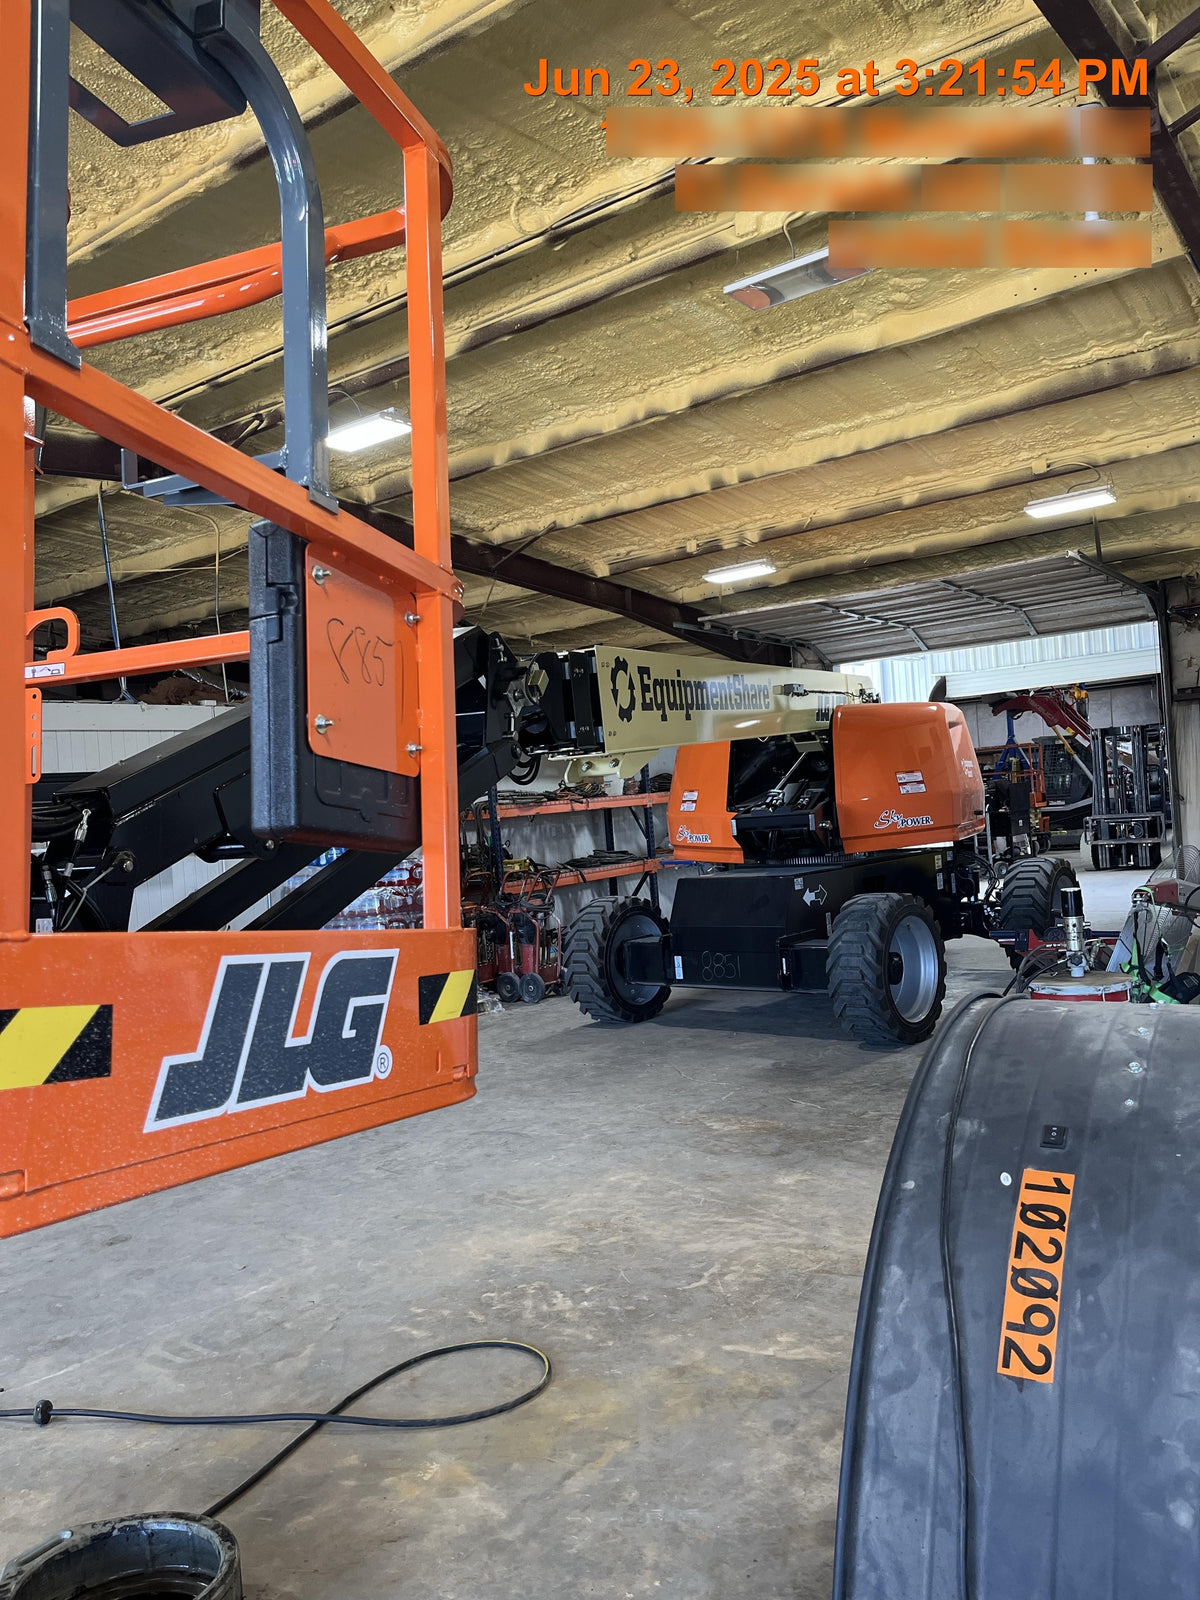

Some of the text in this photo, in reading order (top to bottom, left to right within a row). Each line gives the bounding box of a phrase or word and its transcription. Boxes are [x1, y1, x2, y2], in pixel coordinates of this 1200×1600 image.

[636, 665, 771, 722] EquipmentShare
[702, 950, 741, 982] 8851
[143, 948, 400, 1134] JLG
[1001, 1176, 1072, 1376] 102092
